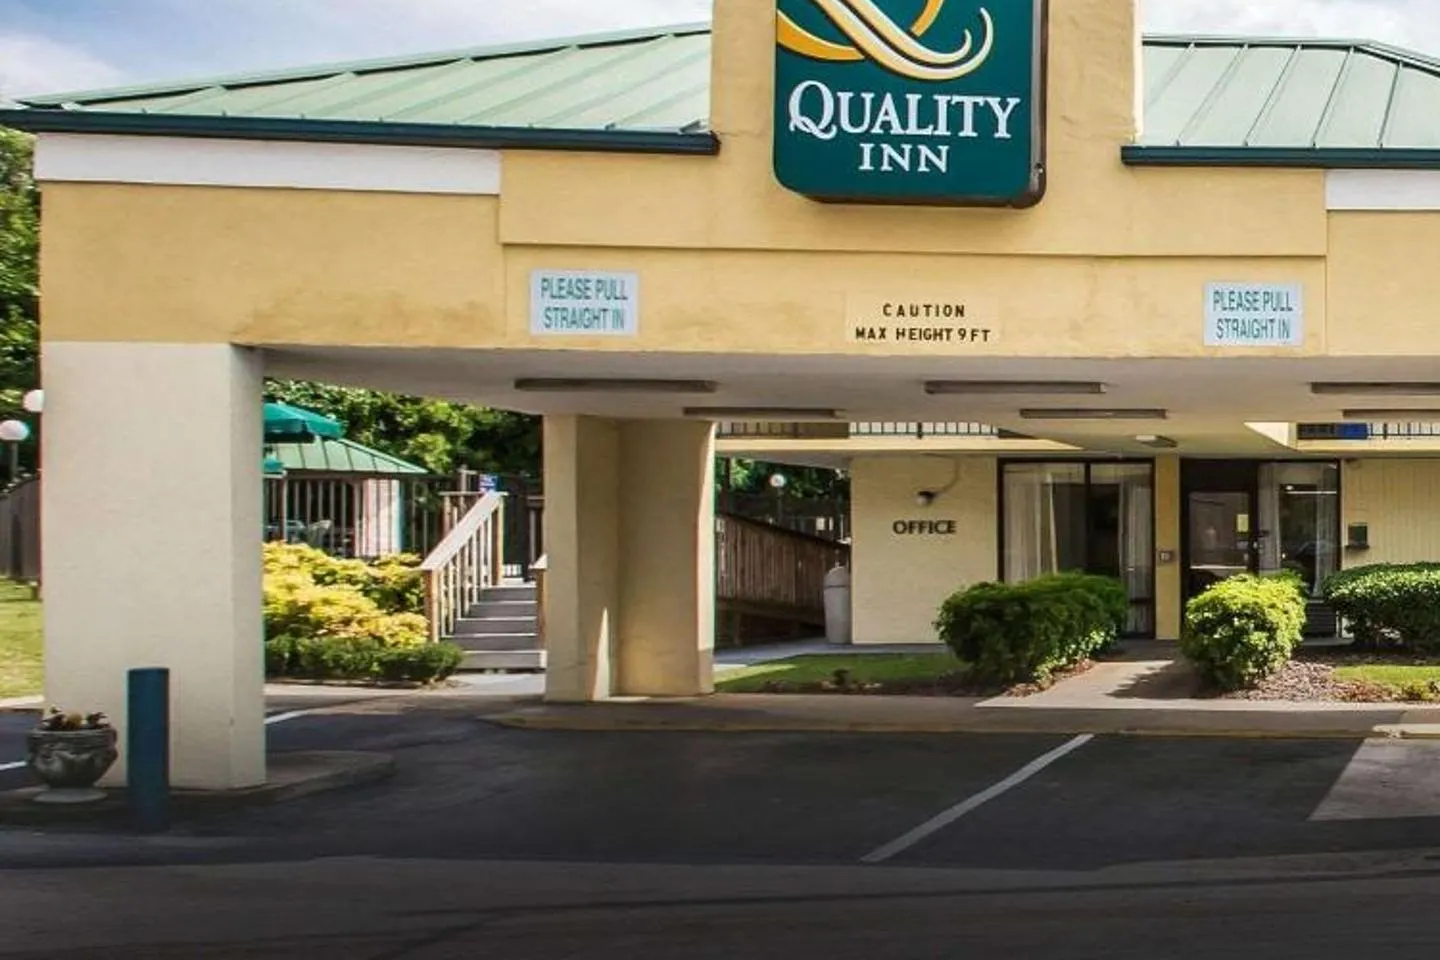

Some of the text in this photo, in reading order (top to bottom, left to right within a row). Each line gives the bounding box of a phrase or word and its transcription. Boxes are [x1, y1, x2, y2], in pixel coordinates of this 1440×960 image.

[788, 80, 1021, 140] QUALITY
[859, 144, 949, 173] INN
[541, 278, 628, 300] PLEASE PULL
[882, 303, 965, 318] CAUTION
[1213, 290, 1293, 311] PLEASE PULL
[544, 307, 624, 328] STRAIGHT IN
[855, 327, 991, 342] MAX HEIGHT 9 FT
[1216, 318, 1290, 339] STRAIGHT IN
[892, 519, 957, 535] OFFICE
